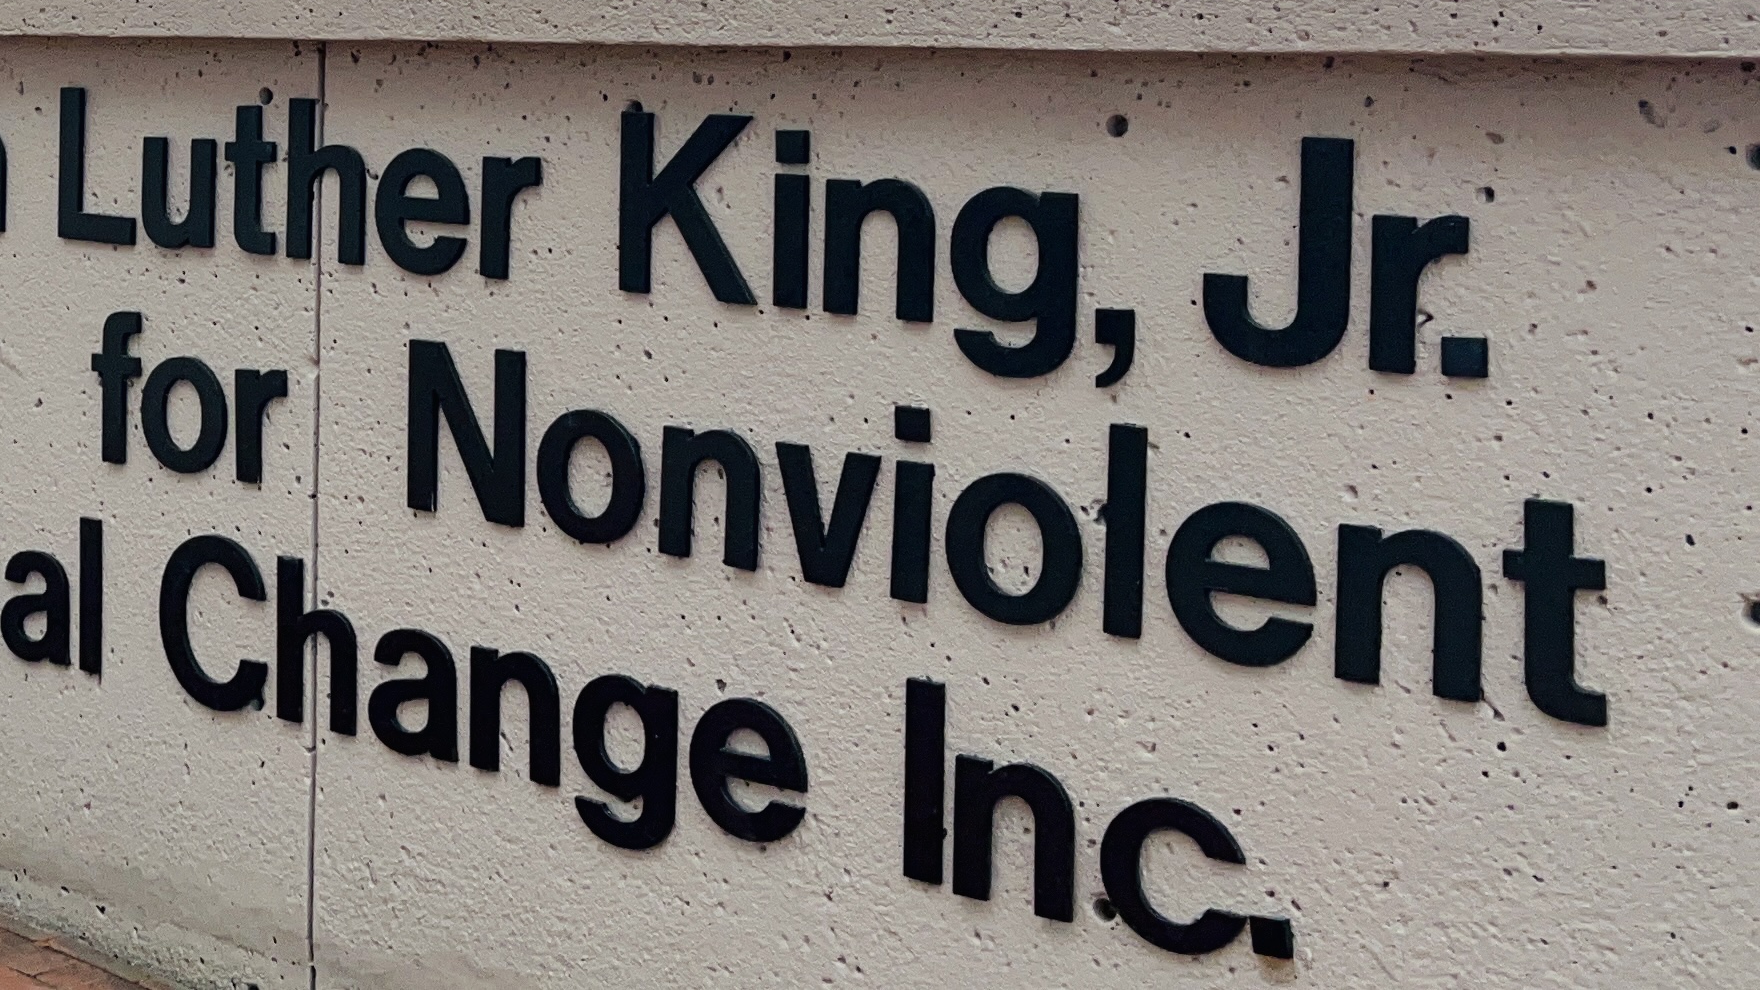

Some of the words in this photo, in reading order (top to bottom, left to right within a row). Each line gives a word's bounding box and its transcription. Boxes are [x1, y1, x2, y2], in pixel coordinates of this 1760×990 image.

[57, 86, 543, 281] Luther
[619, 111, 1137, 388] King,
[1203, 137, 1489, 381] Jr.
[91, 311, 288, 485] for
[407, 339, 1608, 729] Nonviolent
[159, 534, 808, 853] Change
[903, 676, 1294, 961] Inc.
